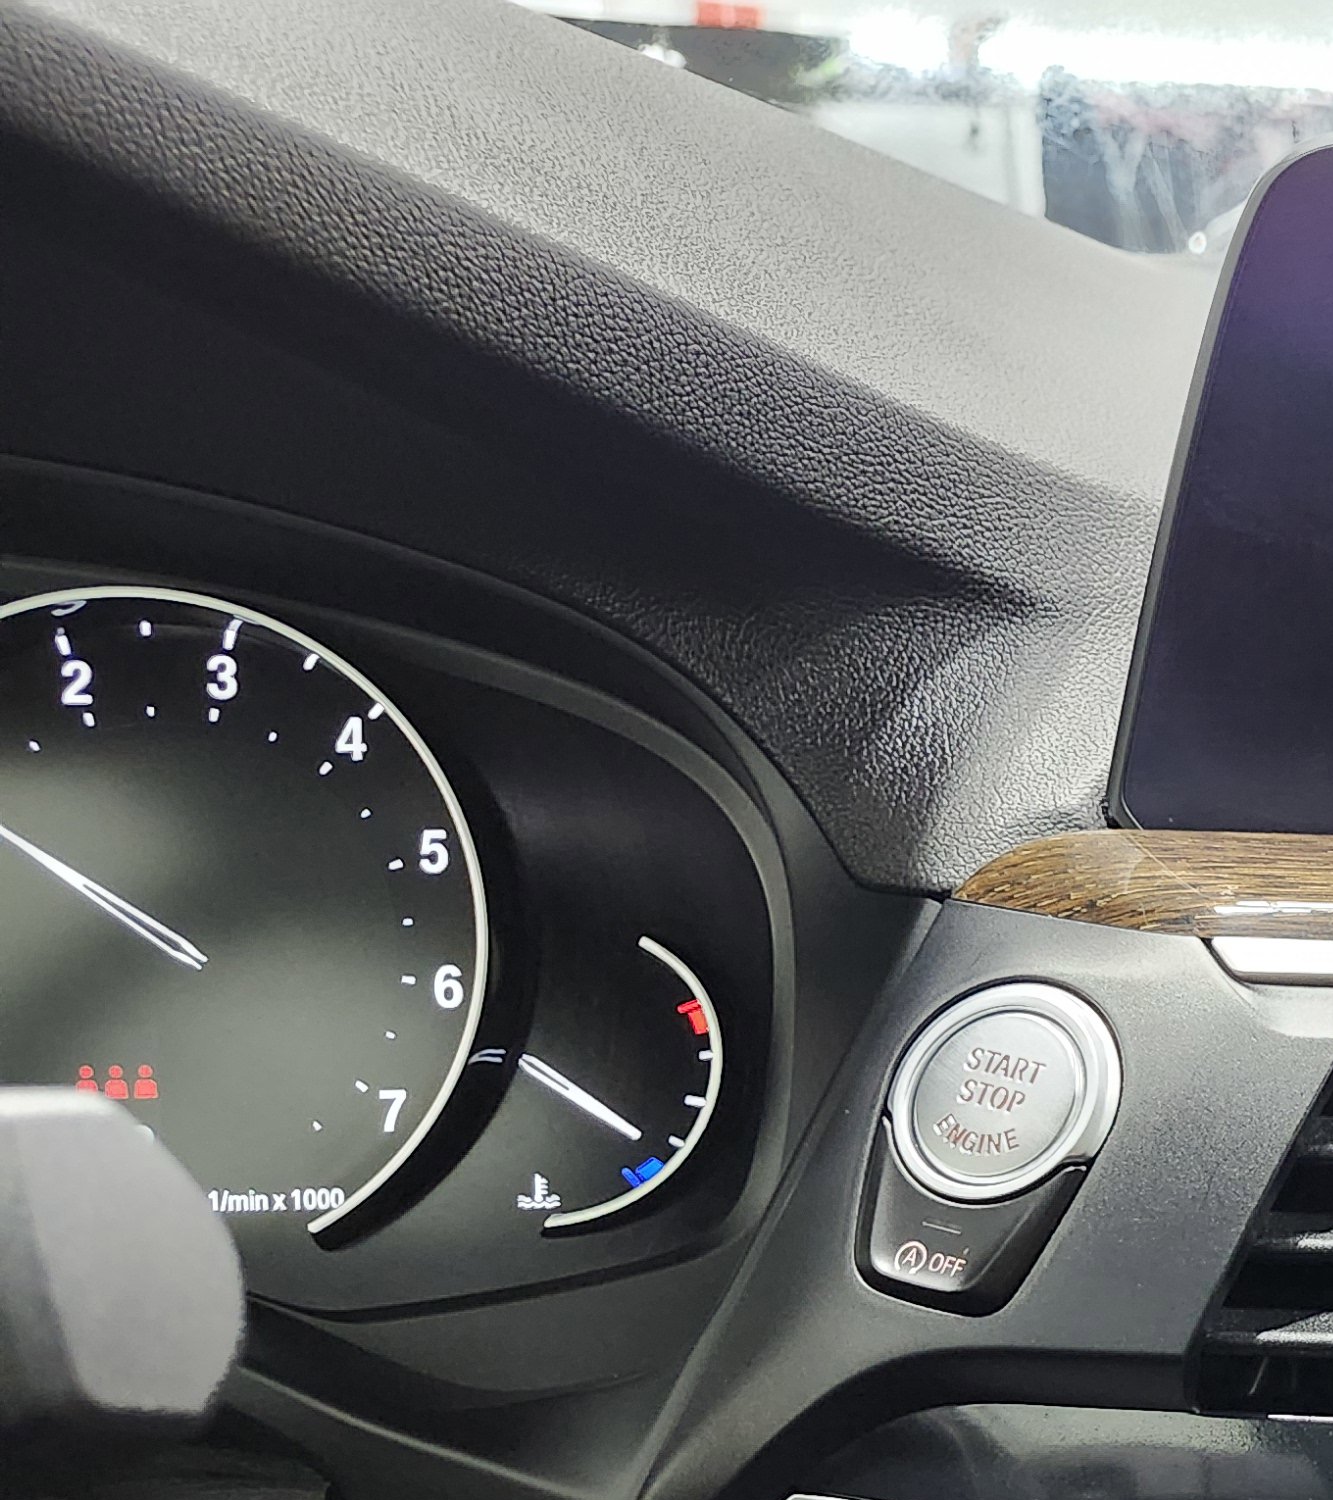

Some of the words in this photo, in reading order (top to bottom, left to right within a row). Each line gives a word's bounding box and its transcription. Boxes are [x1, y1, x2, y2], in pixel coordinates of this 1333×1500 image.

[61, 659, 94, 706] 2
[206, 654, 239, 701] 3
[335, 716, 368, 761] 4
[419, 829, 449, 875] 5
[433, 964, 464, 1009] 6
[964, 1047, 1047, 1085] START
[378, 1088, 407, 1132] 7
[957, 1078, 1026, 1114] STOP
[933, 1113, 1021, 1155] ENGINE
[208, 1187, 268, 1214] 1/min
[272, 1194, 287, 1212] x
[291, 1186, 345, 1212] 1000
[928, 1253, 967, 1278] OFF
